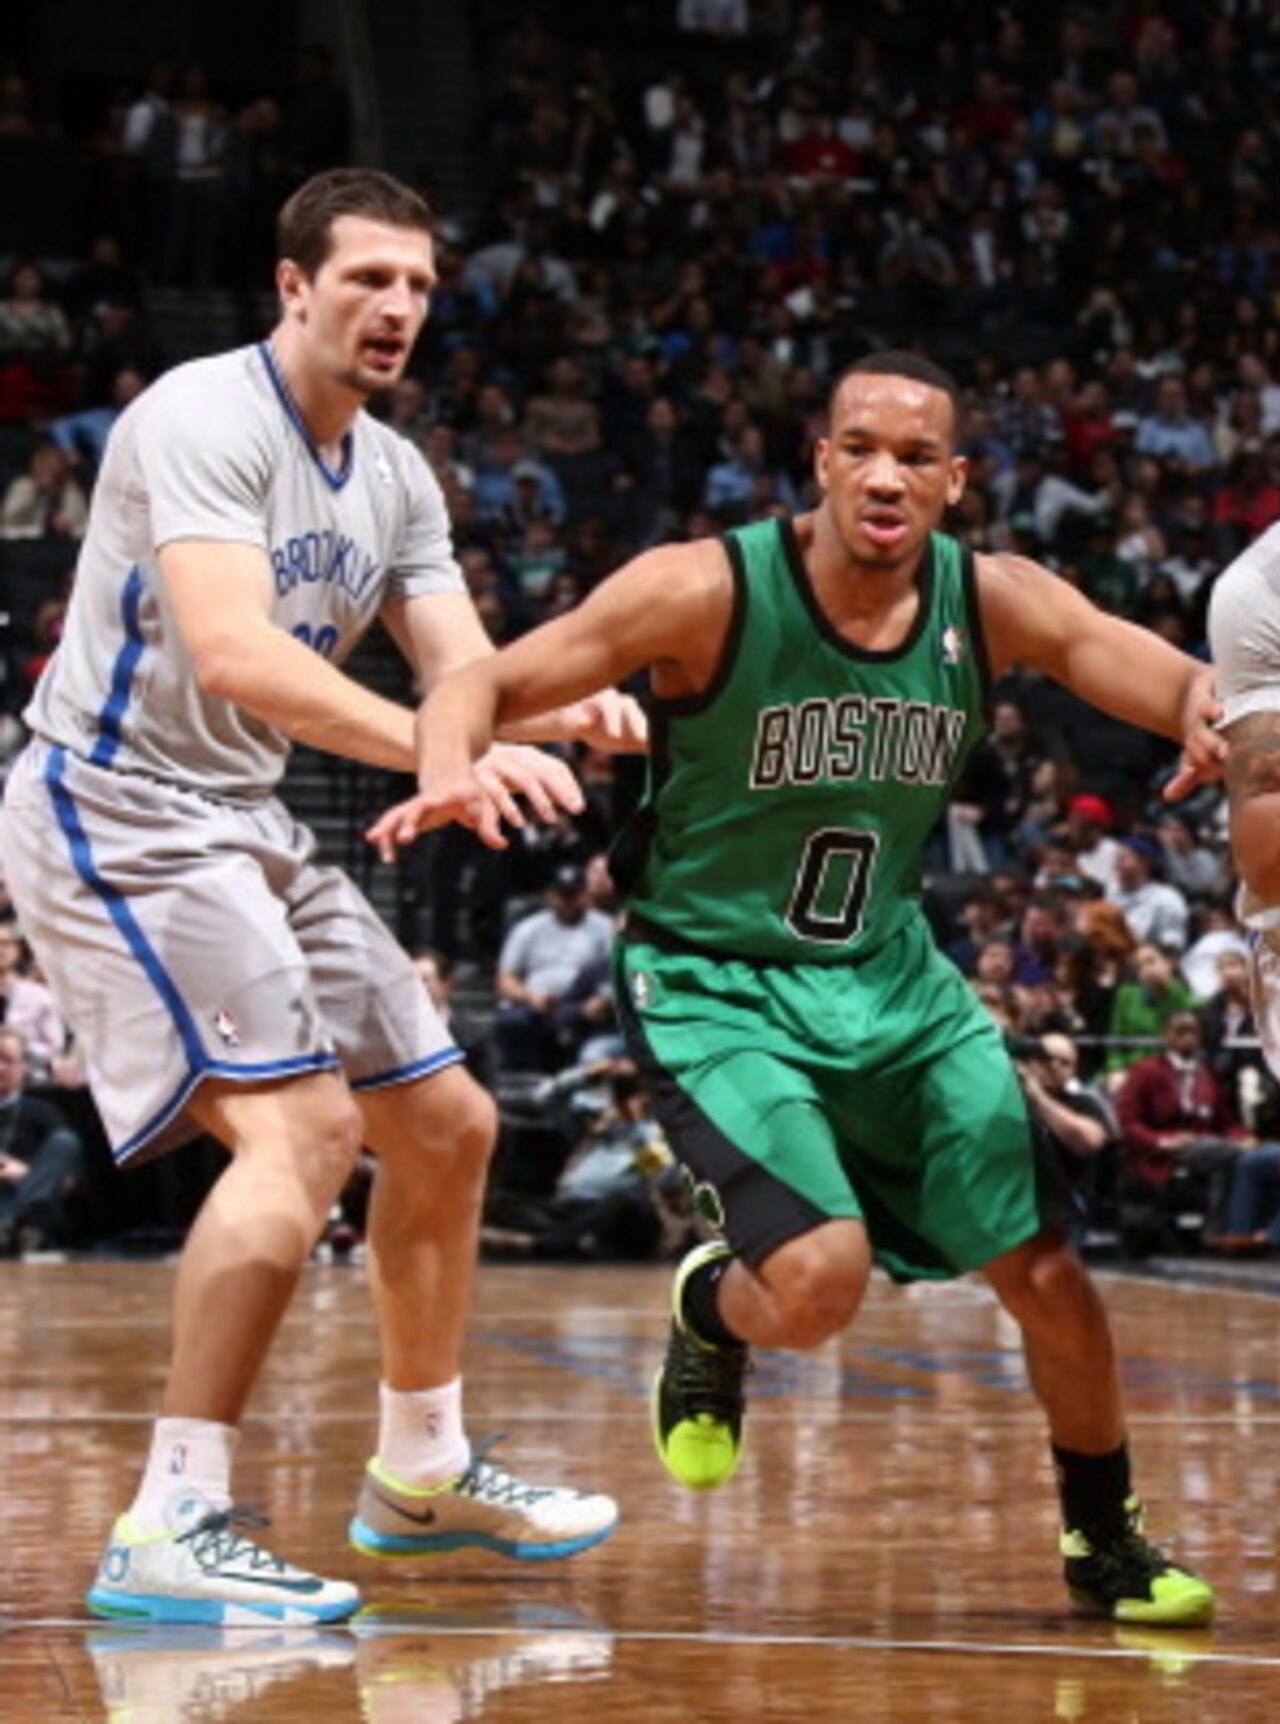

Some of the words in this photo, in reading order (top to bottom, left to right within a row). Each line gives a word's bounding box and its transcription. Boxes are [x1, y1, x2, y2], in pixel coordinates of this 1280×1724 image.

[270, 529, 381, 598] BROOKLY
[749, 693, 967, 791] BOSTON
[784, 827, 880, 946] 0
